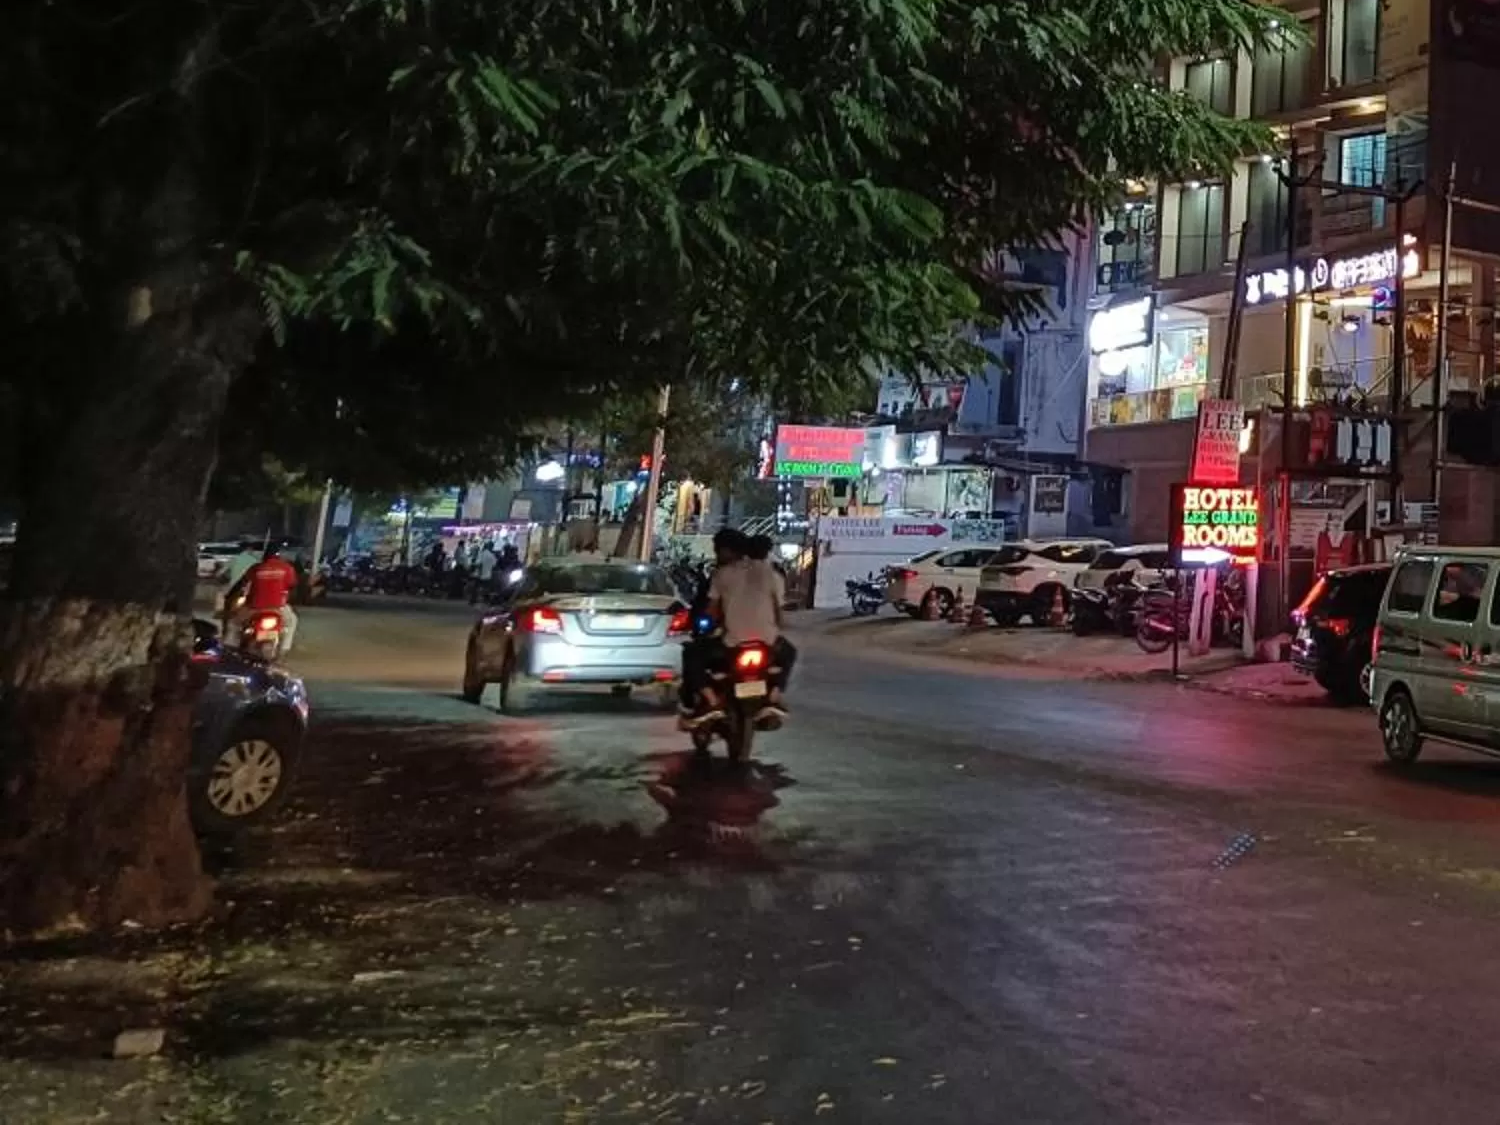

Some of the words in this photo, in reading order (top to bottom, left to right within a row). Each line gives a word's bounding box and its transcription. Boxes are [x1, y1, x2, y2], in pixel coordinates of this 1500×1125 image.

[1184, 488, 1259, 510] HOTEL
[1184, 510, 1209, 525] LEE
[1212, 510, 1257, 525] GRAND
[1182, 525, 1258, 547] ROOMS
